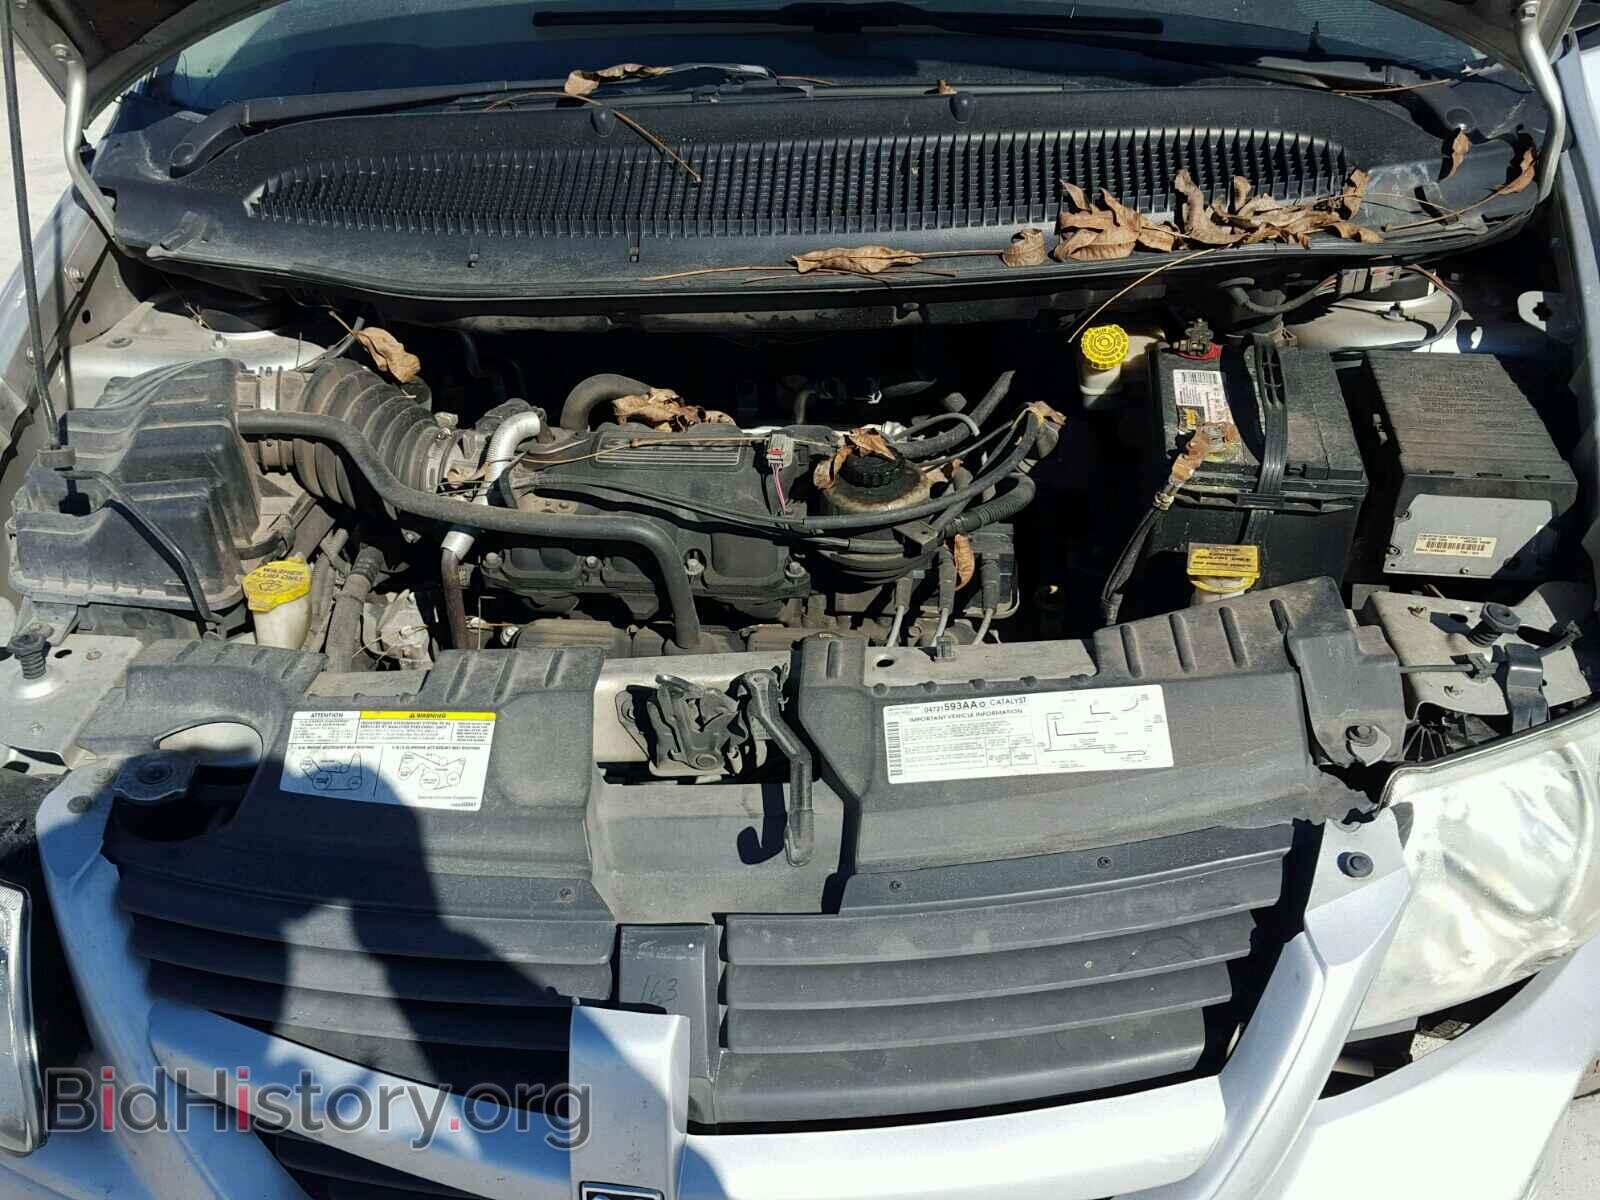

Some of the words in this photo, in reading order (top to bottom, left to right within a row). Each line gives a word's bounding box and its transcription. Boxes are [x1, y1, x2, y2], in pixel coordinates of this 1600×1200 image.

[989, 696, 1027, 706] CATALYST
[910, 714, 946, 722] IMPORTANT
[976, 708, 1023, 717] INFORMATION
[640, 975, 679, 1005] 163
